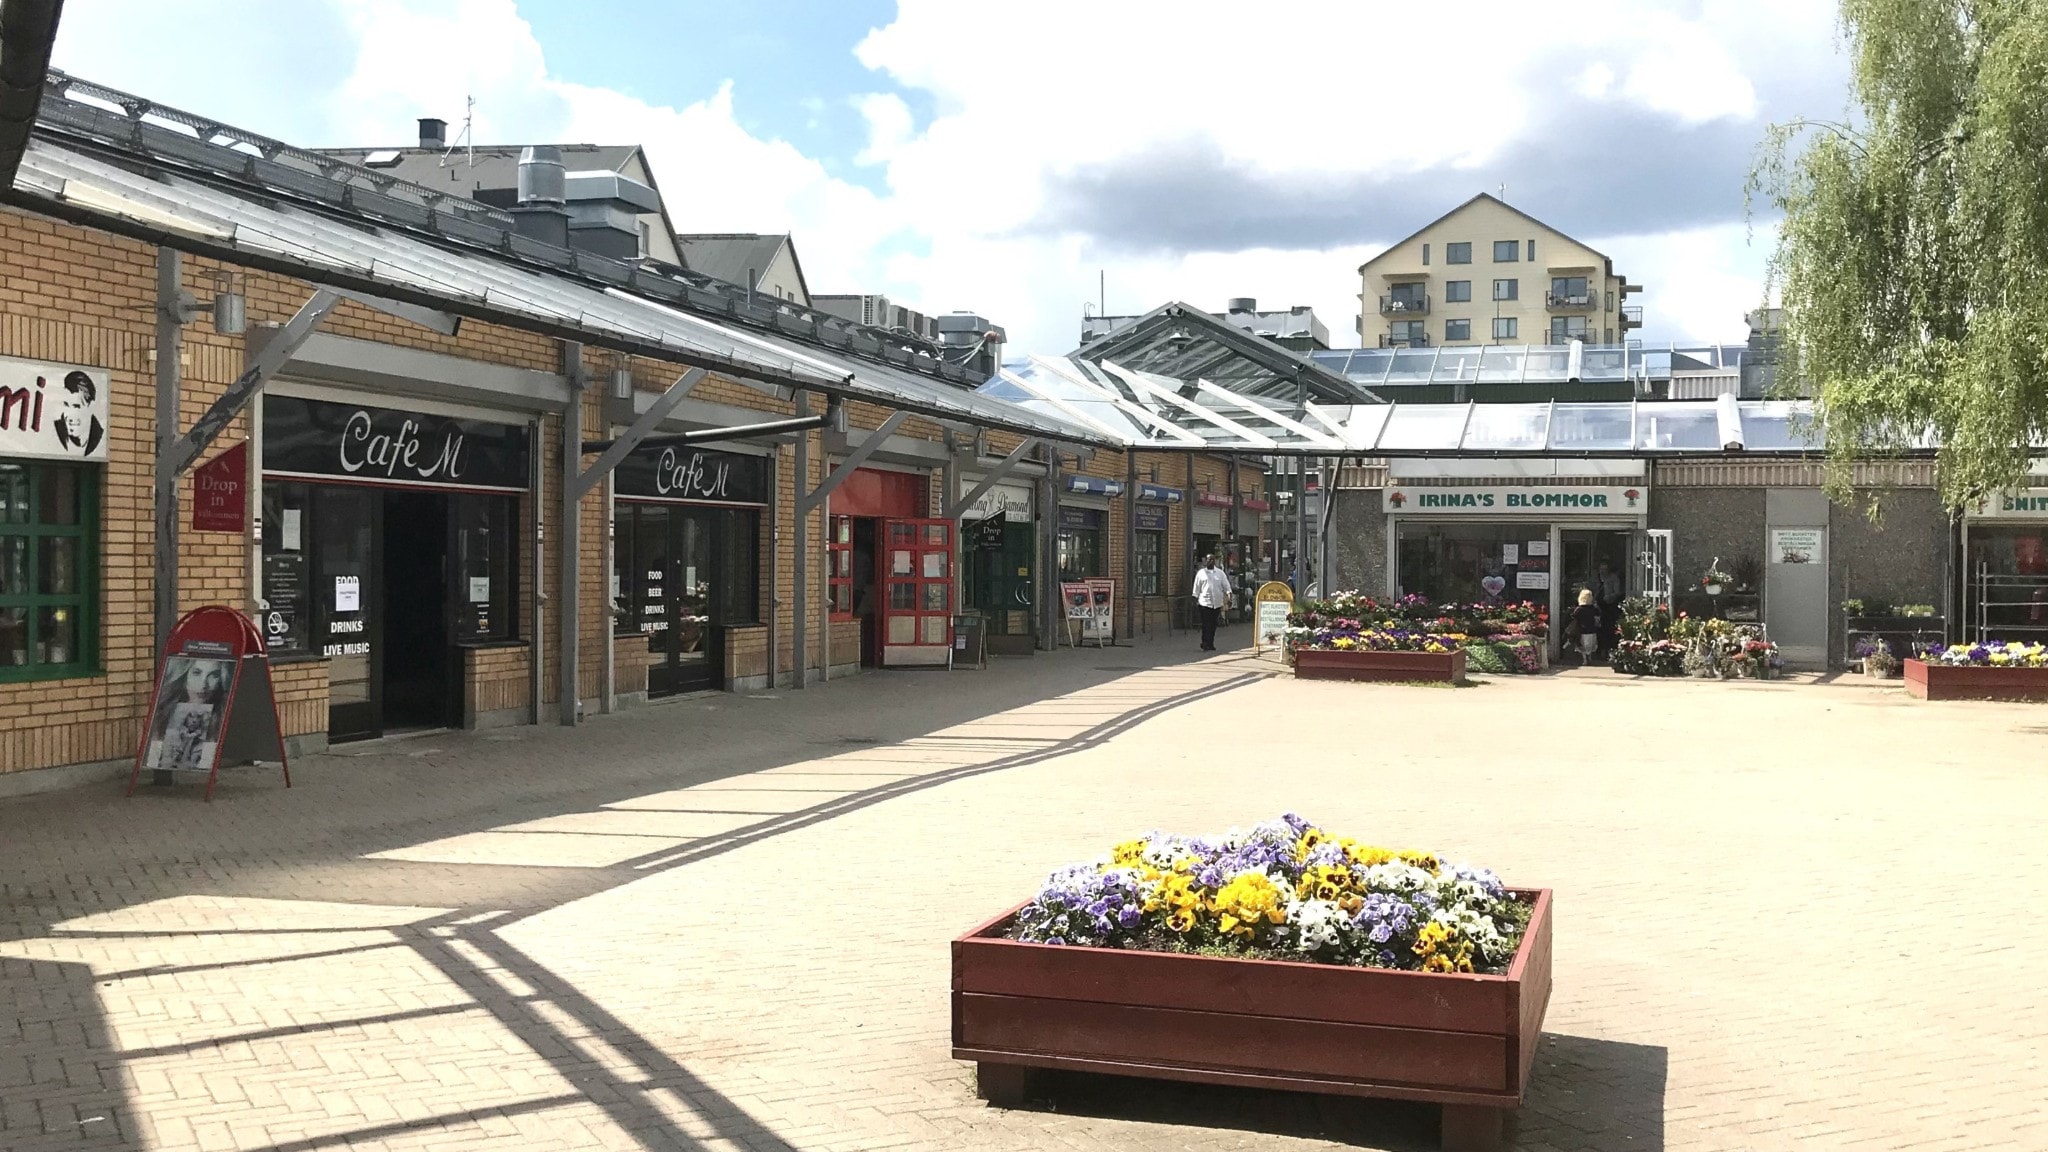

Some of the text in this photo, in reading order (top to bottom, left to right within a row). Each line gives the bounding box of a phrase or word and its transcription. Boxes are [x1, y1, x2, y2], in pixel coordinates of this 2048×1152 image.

[340, 410, 464, 478] Café M
[657, 448, 729, 497] Café M
[202, 475, 238, 495] Drop
[211, 492, 225, 506] in
[1506, 493, 1607, 508] BLOMMOR
[983, 526, 1002, 536] Drop
[336, 576, 359, 584] FOOD
[648, 570, 663, 580] FOOD
[648, 588, 662, 597] BEER
[645, 604, 665, 614] DRINKS
[330, 620, 364, 634] DRINKS
[641, 621, 669, 632] LIVE MUSIC
[323, 642, 370, 657] LIVE MUSIC
